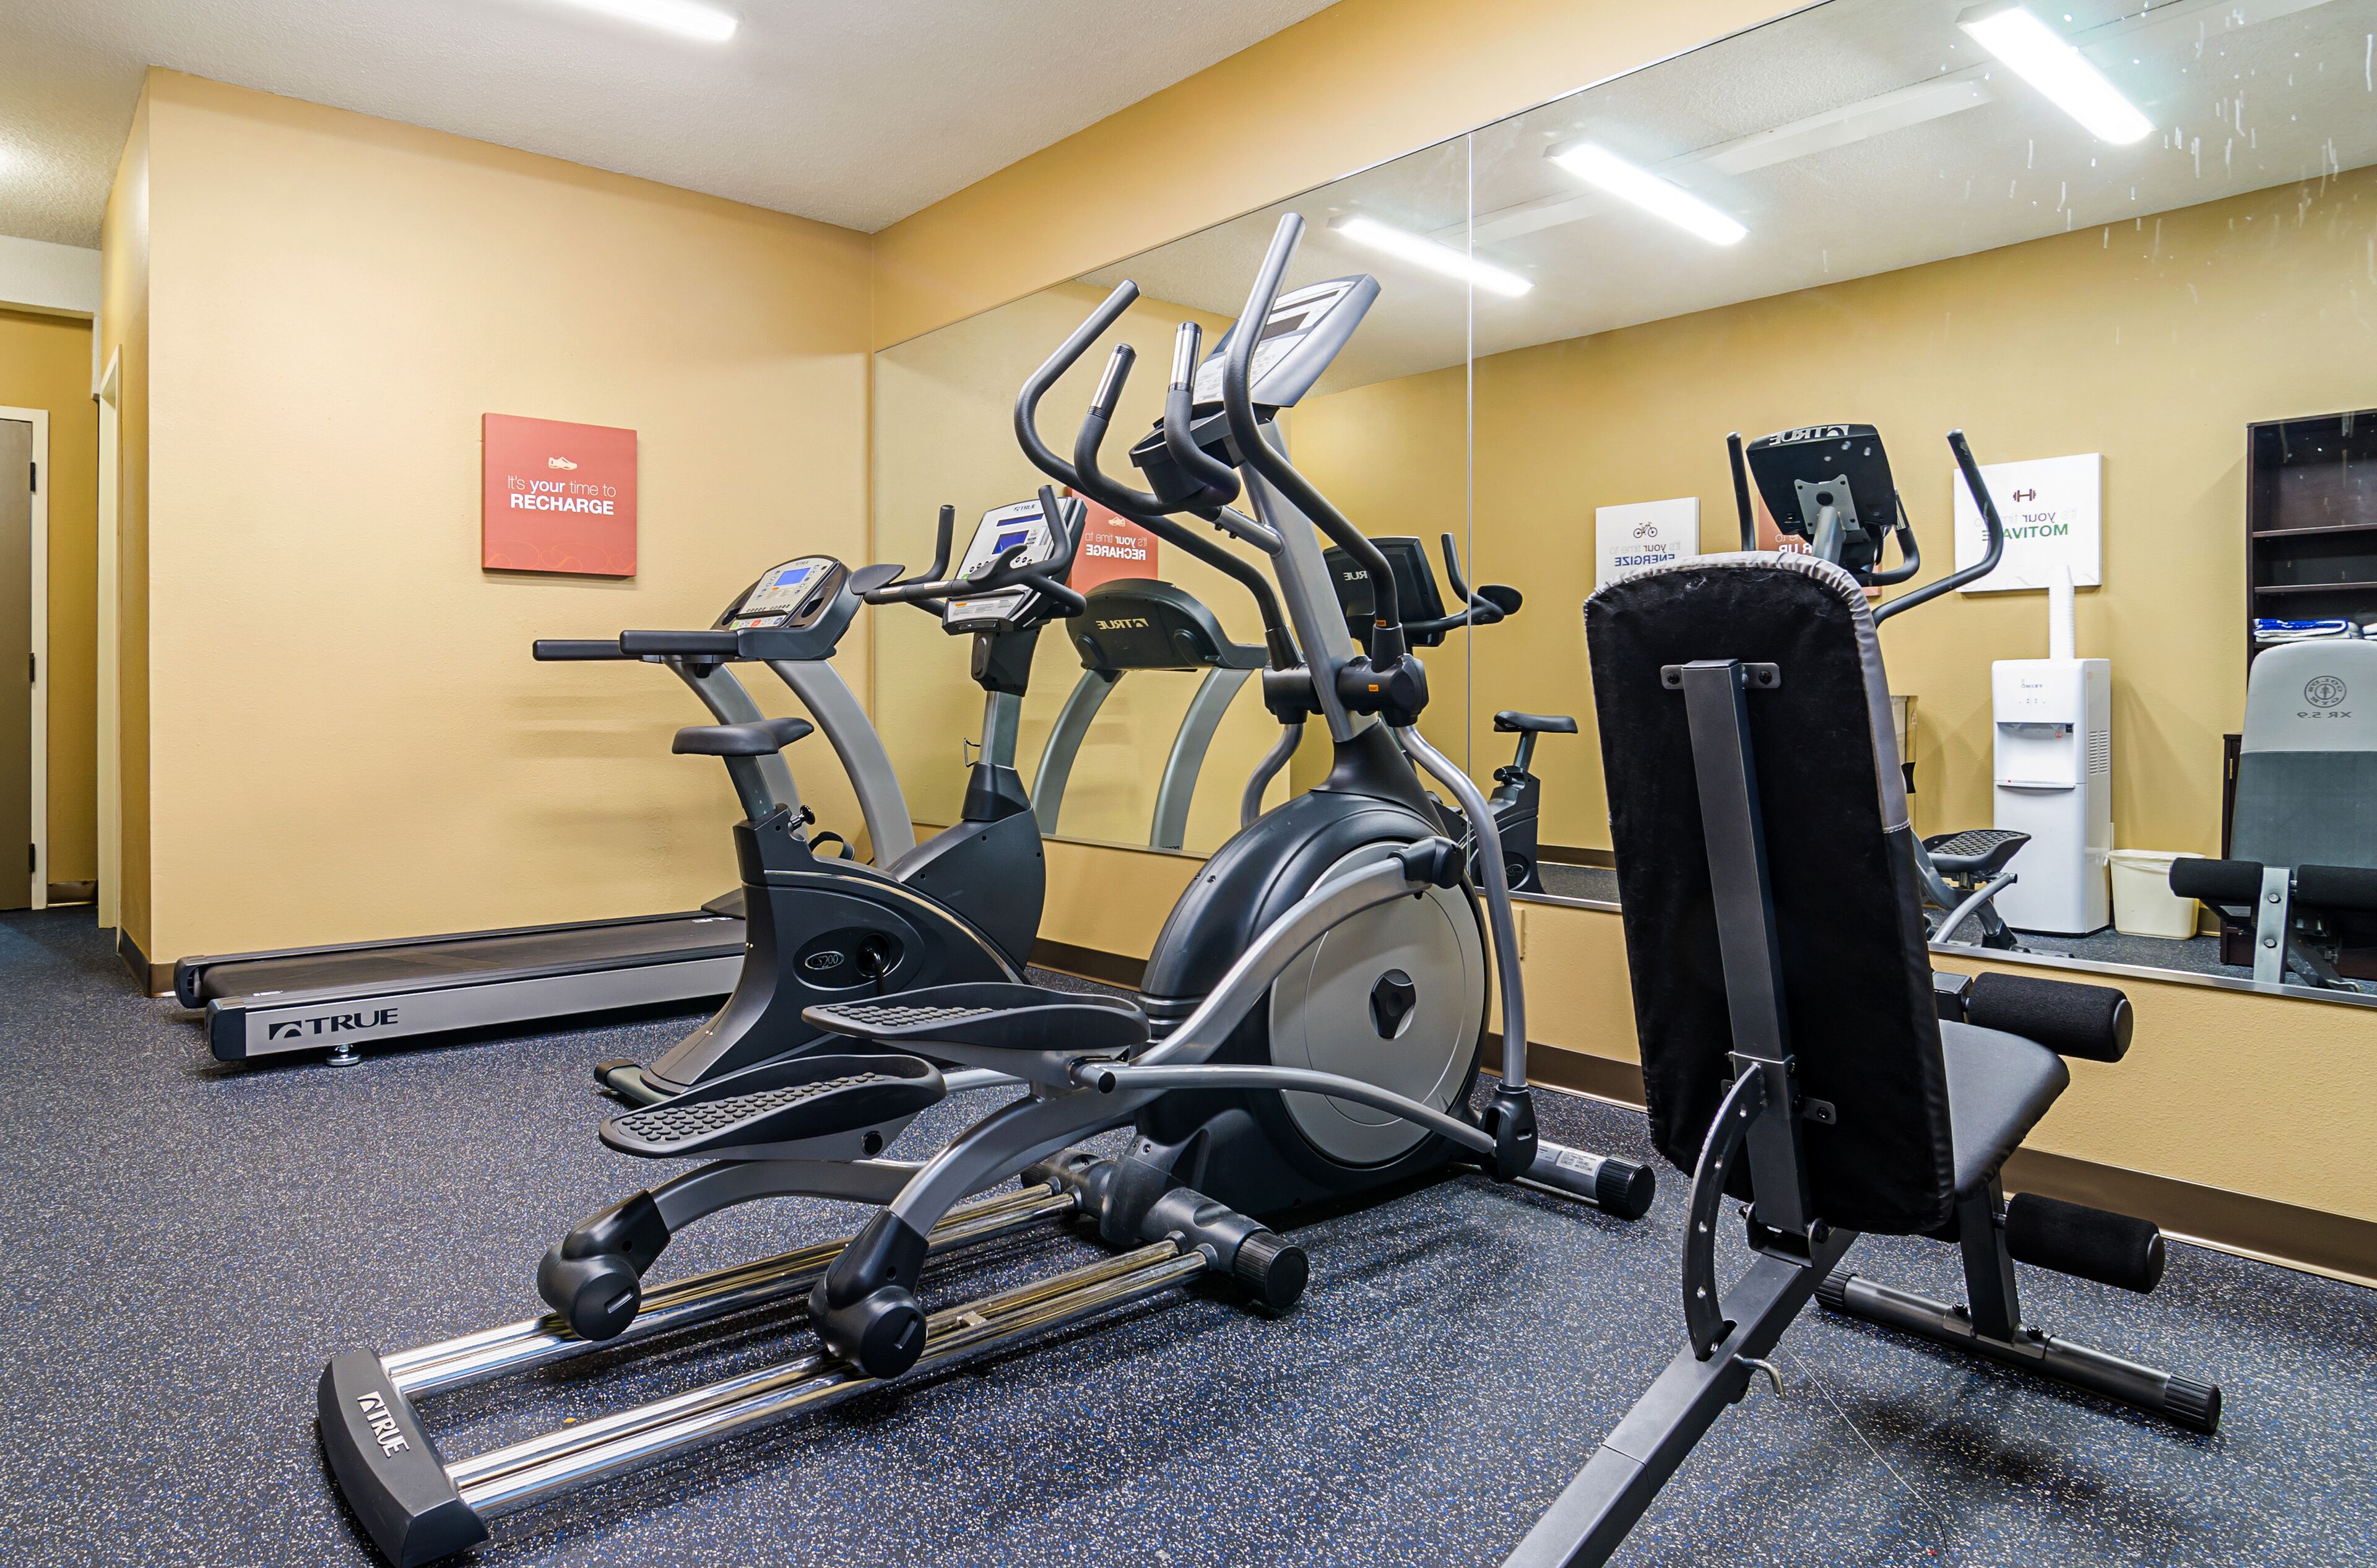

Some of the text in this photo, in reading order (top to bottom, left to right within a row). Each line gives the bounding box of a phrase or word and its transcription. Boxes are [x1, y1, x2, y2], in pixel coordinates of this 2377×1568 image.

[508, 475, 617, 497] It's your time to
[510, 493, 614, 516] RECHARGE
[812, 955, 838, 968] CS200
[305, 1007, 398, 1035] TRUE
[366, 1405, 410, 1458] TRUE
